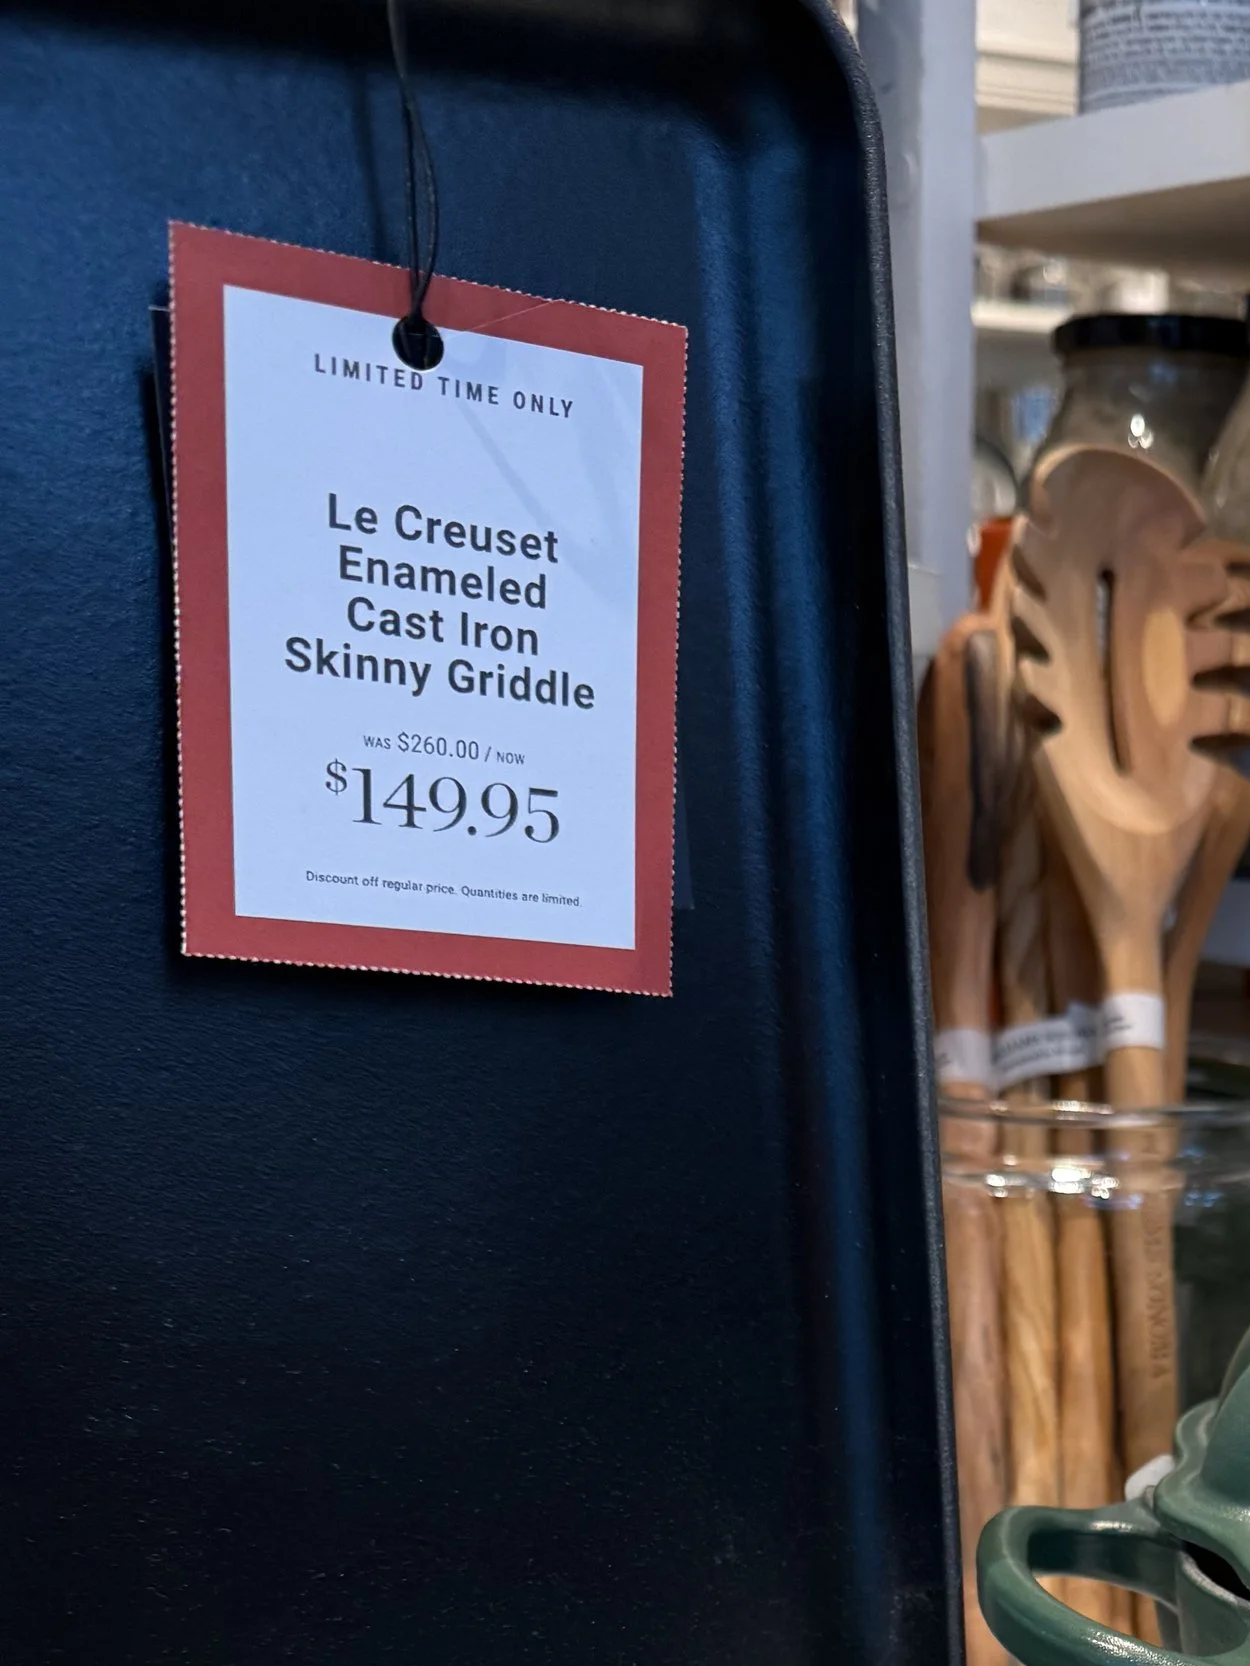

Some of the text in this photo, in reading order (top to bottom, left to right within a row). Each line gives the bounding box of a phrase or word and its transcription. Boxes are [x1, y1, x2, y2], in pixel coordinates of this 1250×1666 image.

[314, 353, 574, 419] LIMITED TIME ONLY
[328, 492, 559, 564] Le Creuset
[338, 544, 547, 610] Enameled
[346, 596, 539, 656] Cast Iron
[285, 636, 596, 710] Skinny Griddle
[363, 735, 392, 750] WAS
[397, 731, 480, 761] $260.00
[495, 751, 526, 766] NOW
[324, 757, 561, 844] $149.95
[305, 870, 359, 886] Discount
[361, 877, 380, 888] off
[382, 879, 423, 893] regular
[460, 885, 519, 902] Quantities
[521, 893, 540, 903] are
